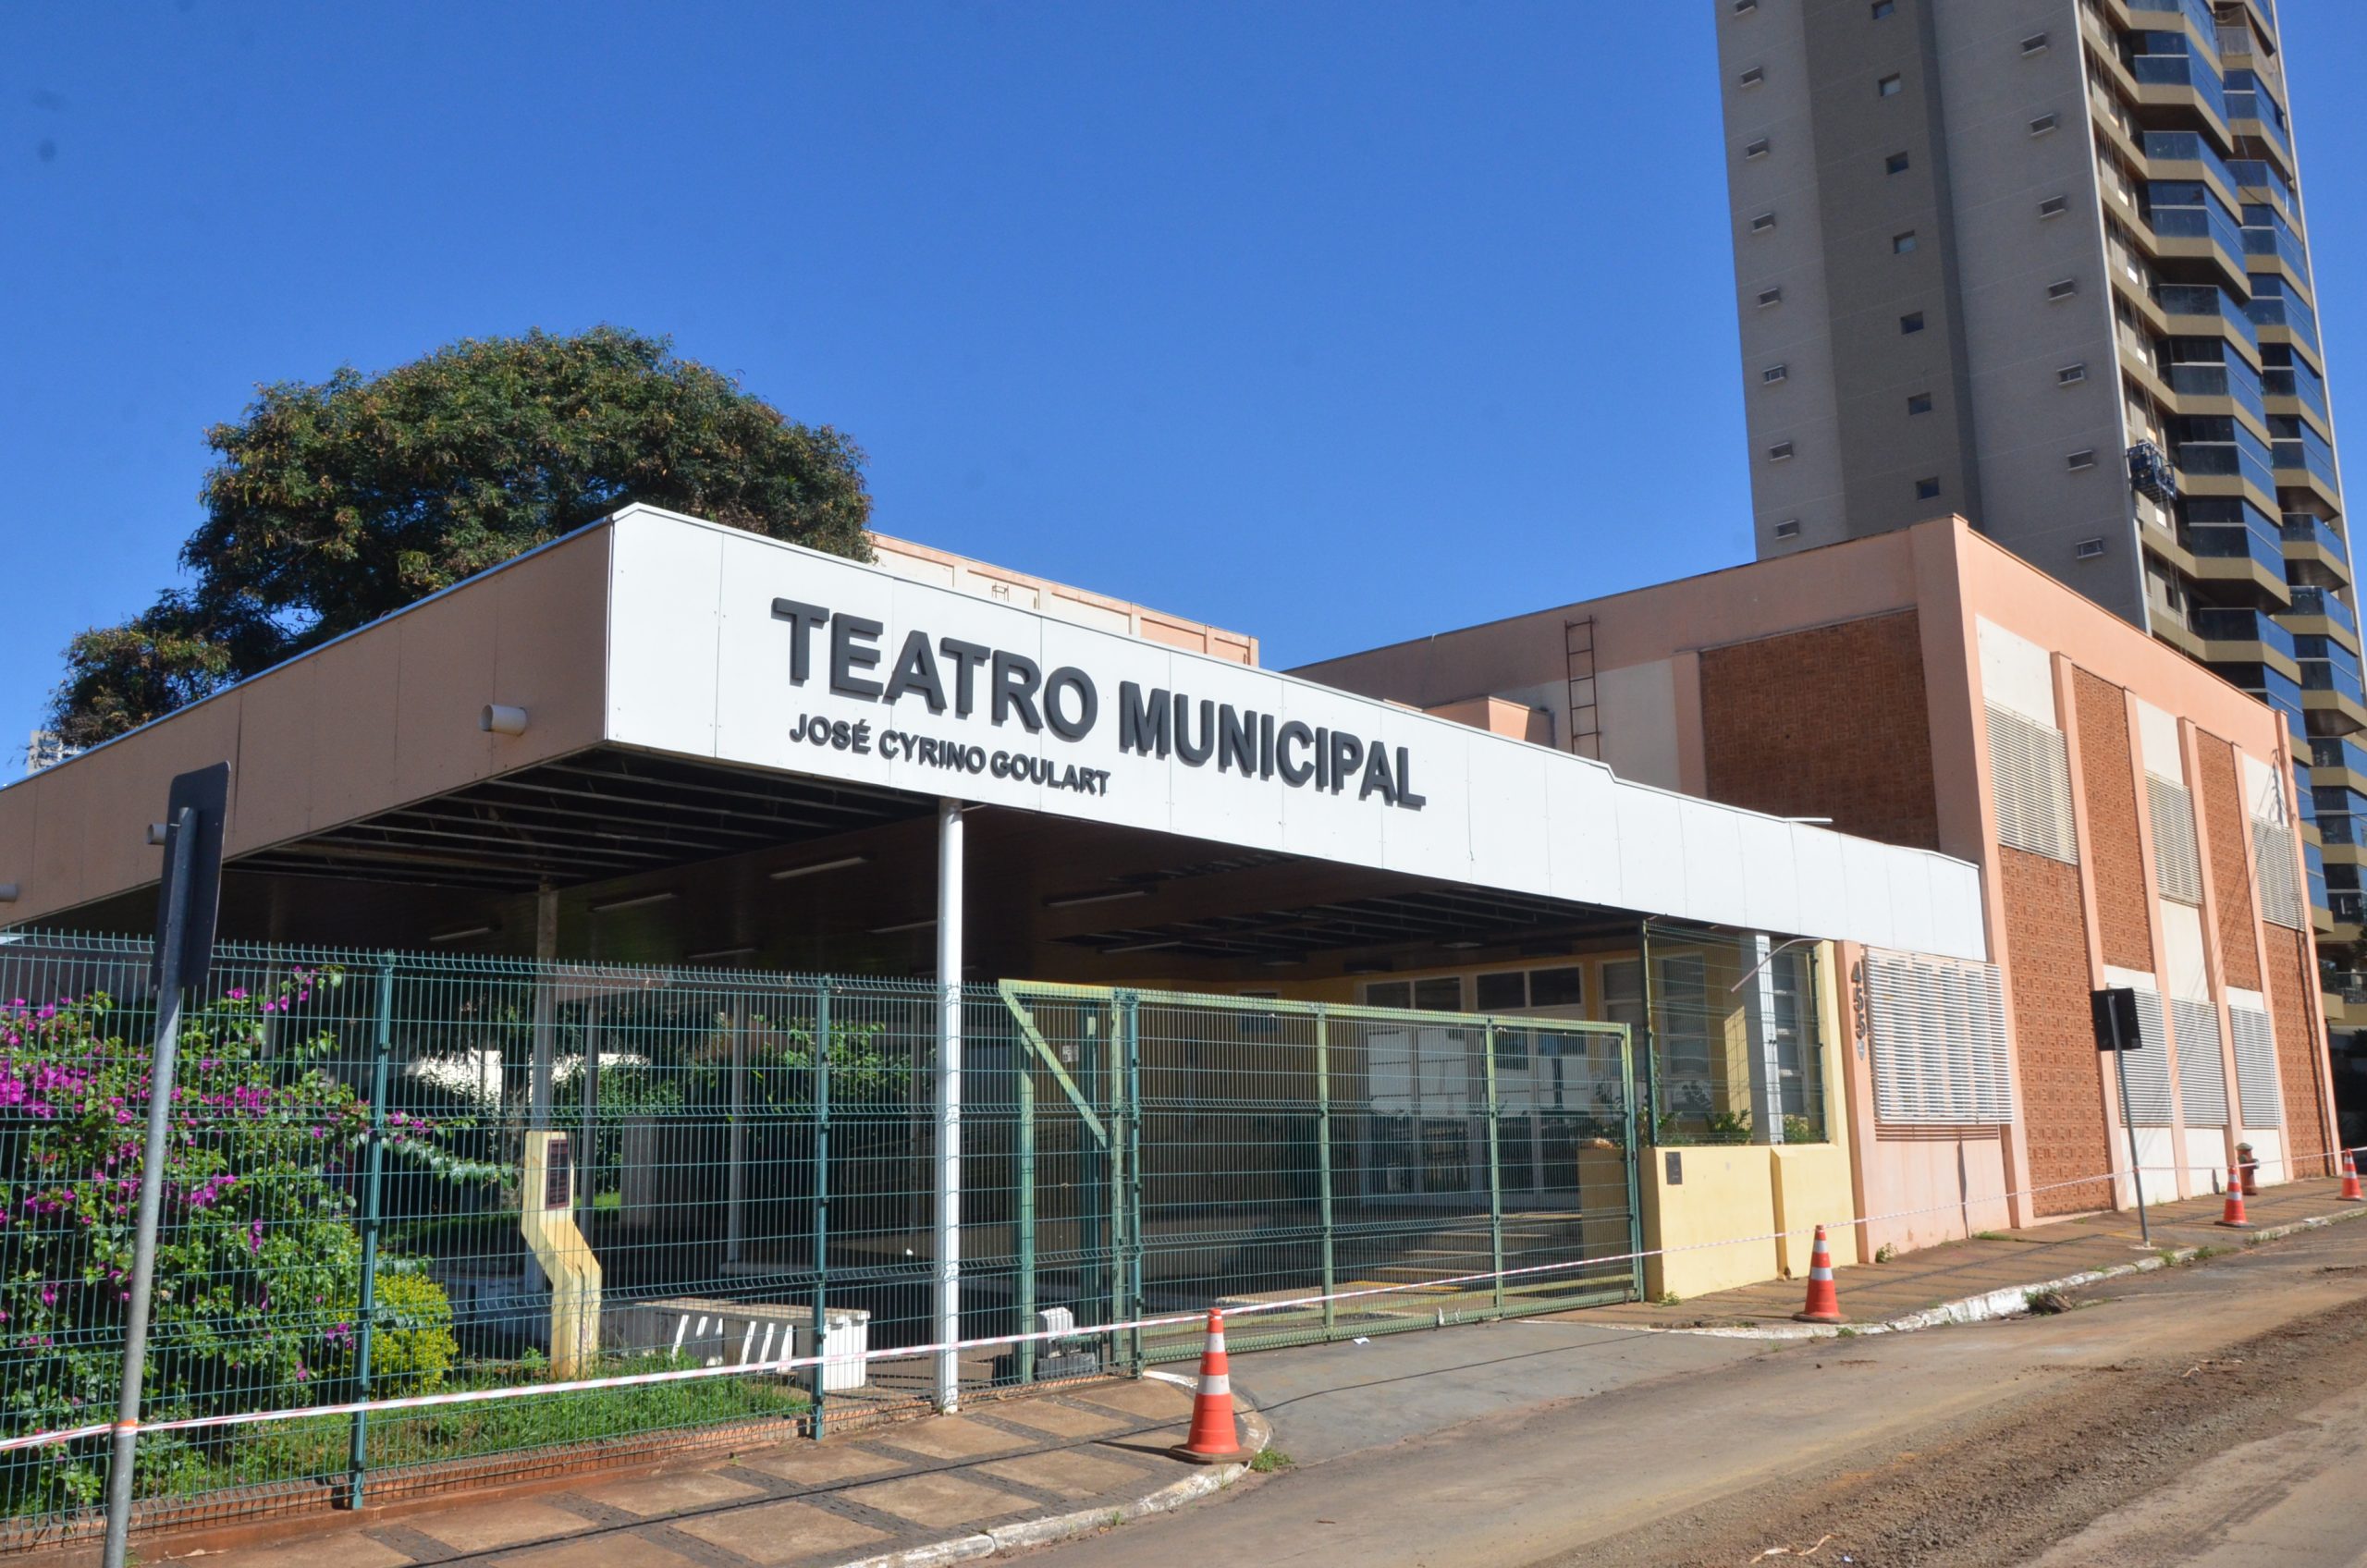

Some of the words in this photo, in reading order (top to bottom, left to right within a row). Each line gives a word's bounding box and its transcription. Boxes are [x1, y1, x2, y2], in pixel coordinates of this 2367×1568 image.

[771, 597, 1098, 742] TEATRO
[1119, 680, 1427, 811] MUNICIPAL
[789, 713, 872, 754] JOSÉ
[878, 729, 987, 775] CYRINO
[990, 751, 1110, 796] GOULART
[1850, 961, 1867, 1040] 455
